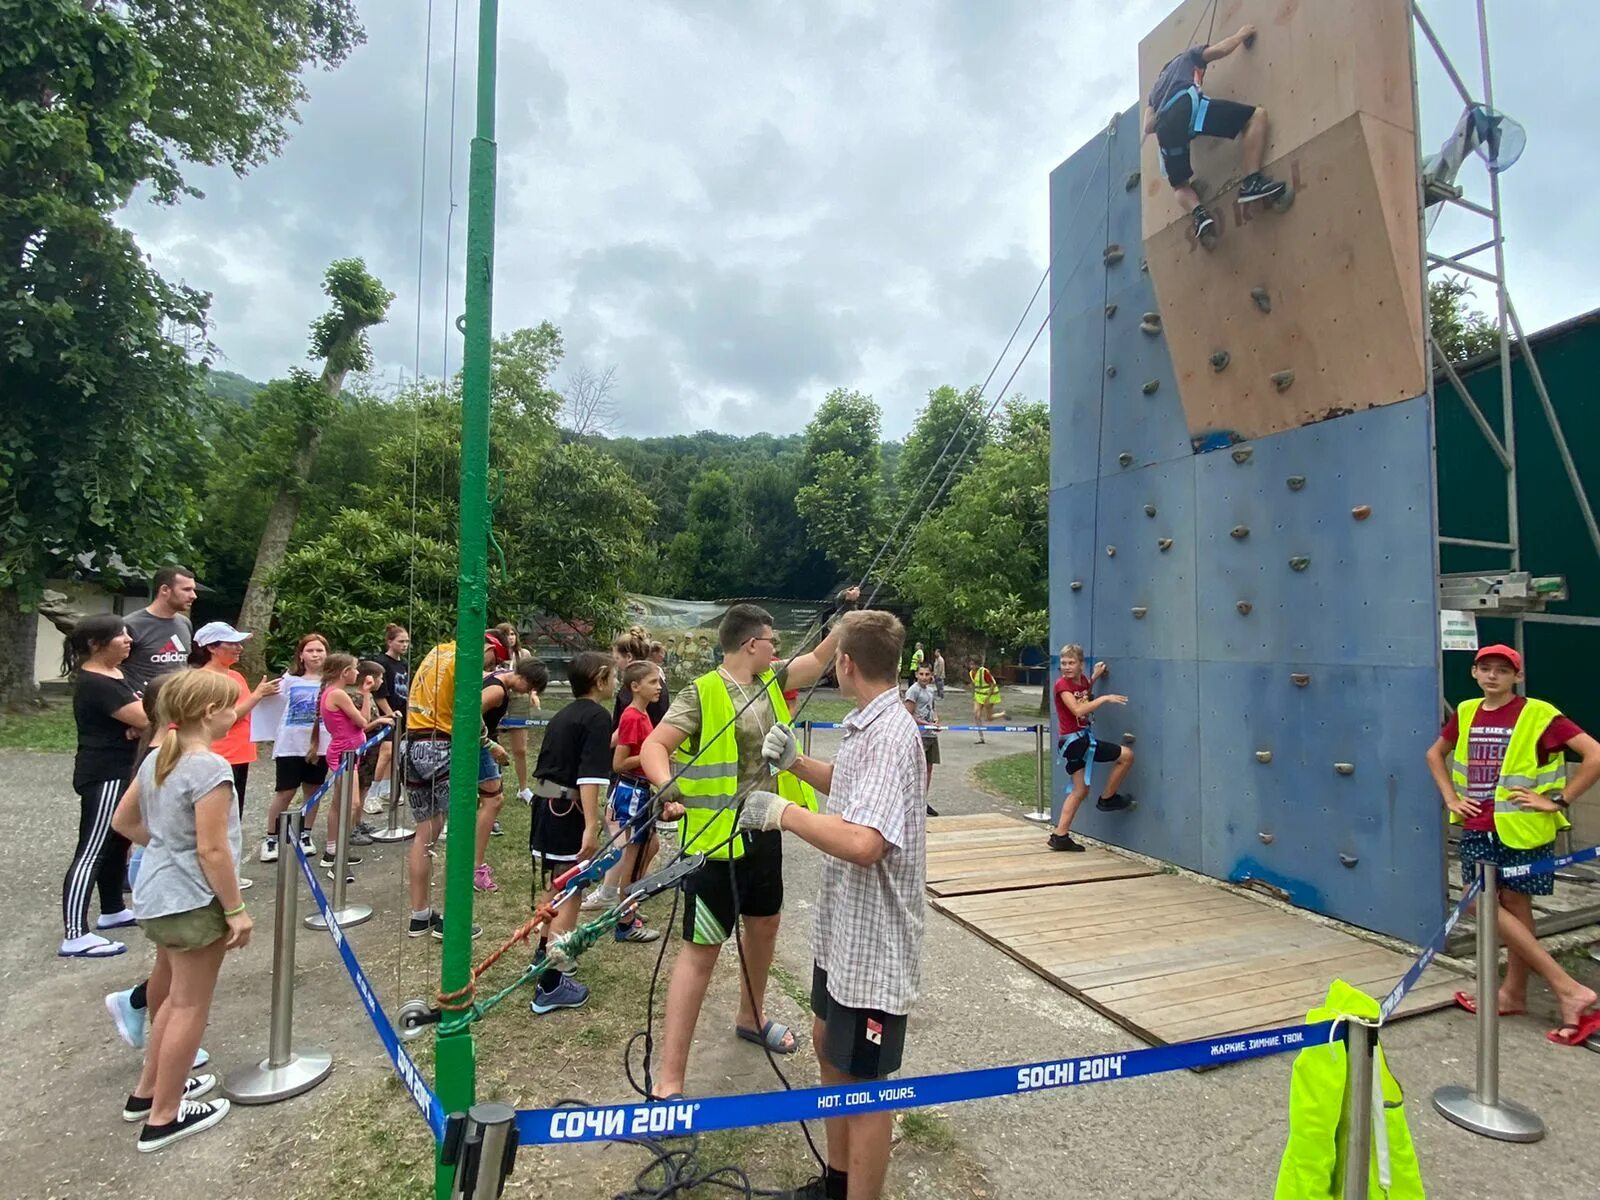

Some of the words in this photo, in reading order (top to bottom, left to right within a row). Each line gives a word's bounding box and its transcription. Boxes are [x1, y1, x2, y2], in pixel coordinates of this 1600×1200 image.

[1210, 1041, 1248, 1056] ЖАРКИЕ.
[1017, 1062, 1075, 1090] SOCHI
[817, 1094, 842, 1109] HOT.
[845, 1091, 875, 1106] COOL.
[878, 1086, 917, 1102] YOURS.
[549, 1109, 626, 1138] СОЧИ
